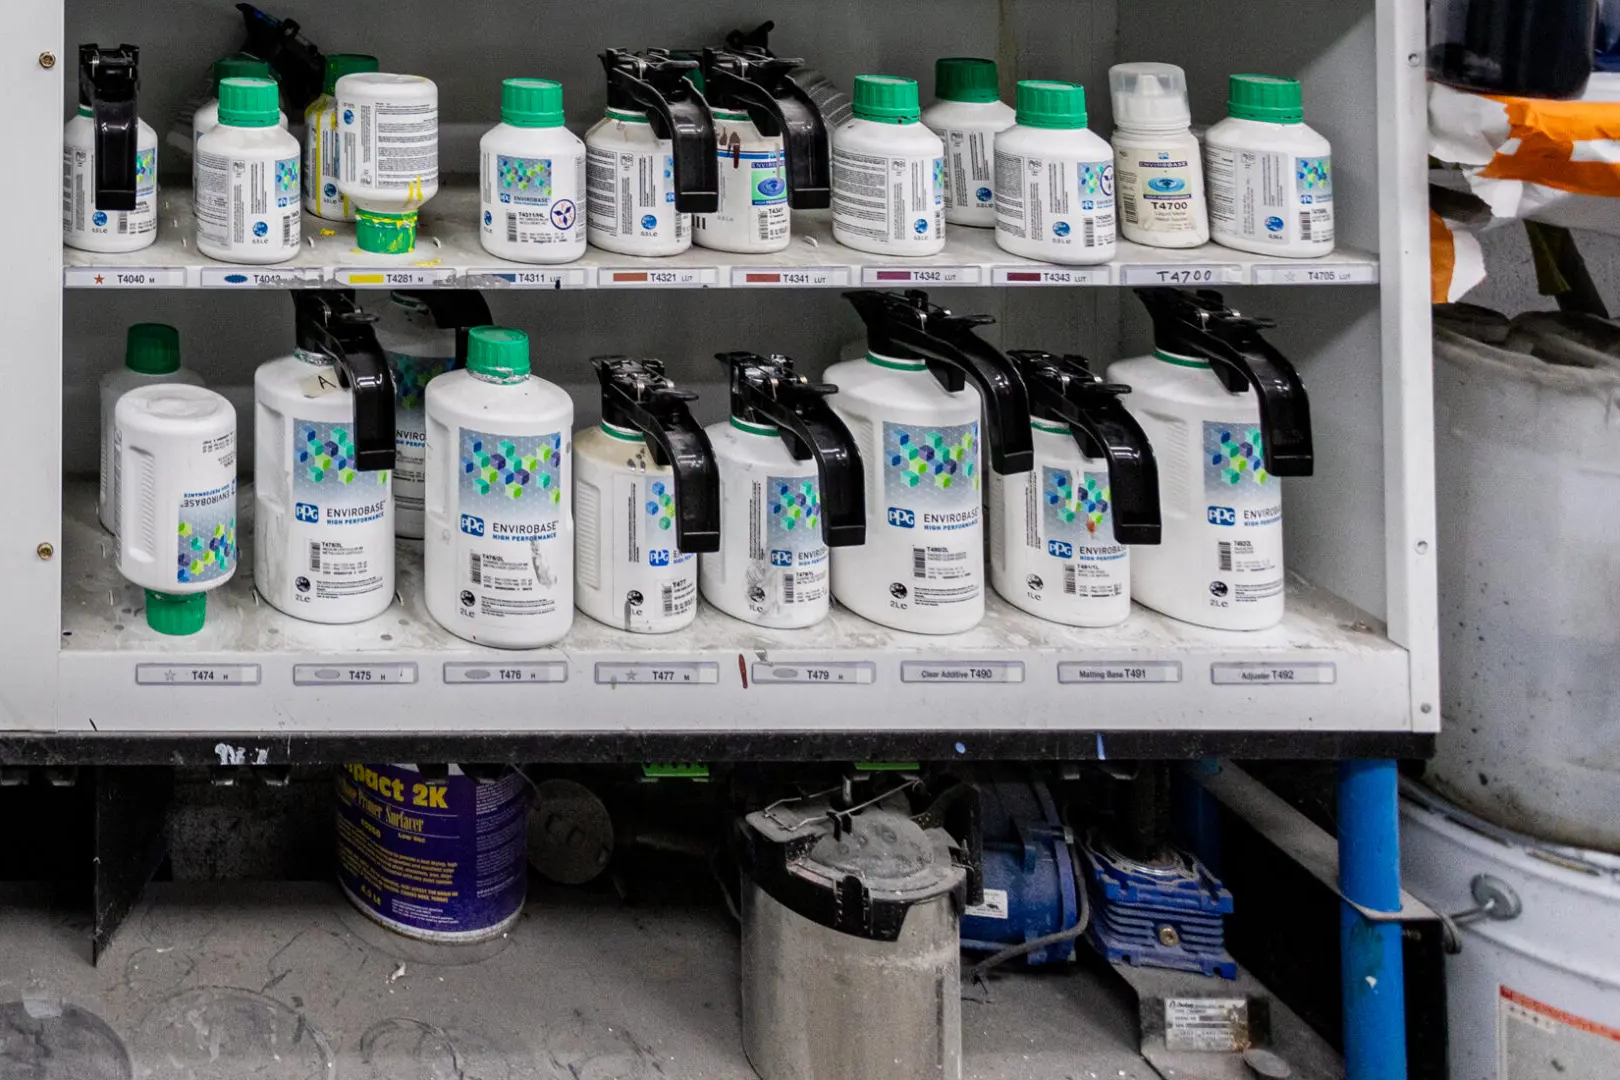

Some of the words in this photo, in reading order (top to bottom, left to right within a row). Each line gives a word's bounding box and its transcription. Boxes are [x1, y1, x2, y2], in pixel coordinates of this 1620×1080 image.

[1151, 202, 1188, 210] T4700
[116, 274, 145, 284] T4040
[386, 274, 413, 283] T4281
[518, 273, 544, 282] T4311
[650, 273, 677, 282] T4321
[782, 274, 810, 283] T4341
[913, 271, 940, 280] T4342
[1042, 273, 1070, 282] T4343
[1156, 270, 1212, 283] T4700
[1307, 271, 1335, 280] T4705
[192, 671, 214, 680] T474
[349, 670, 371, 680] T475
[500, 670, 521, 679] T476
[652, 671, 674, 680] T477
[807, 670, 829, 680] T479
[970, 669, 992, 679] T490
[1125, 668, 1146, 679] T491
[1272, 670, 1294, 680] T492
[412, 783, 449, 808] 2K
